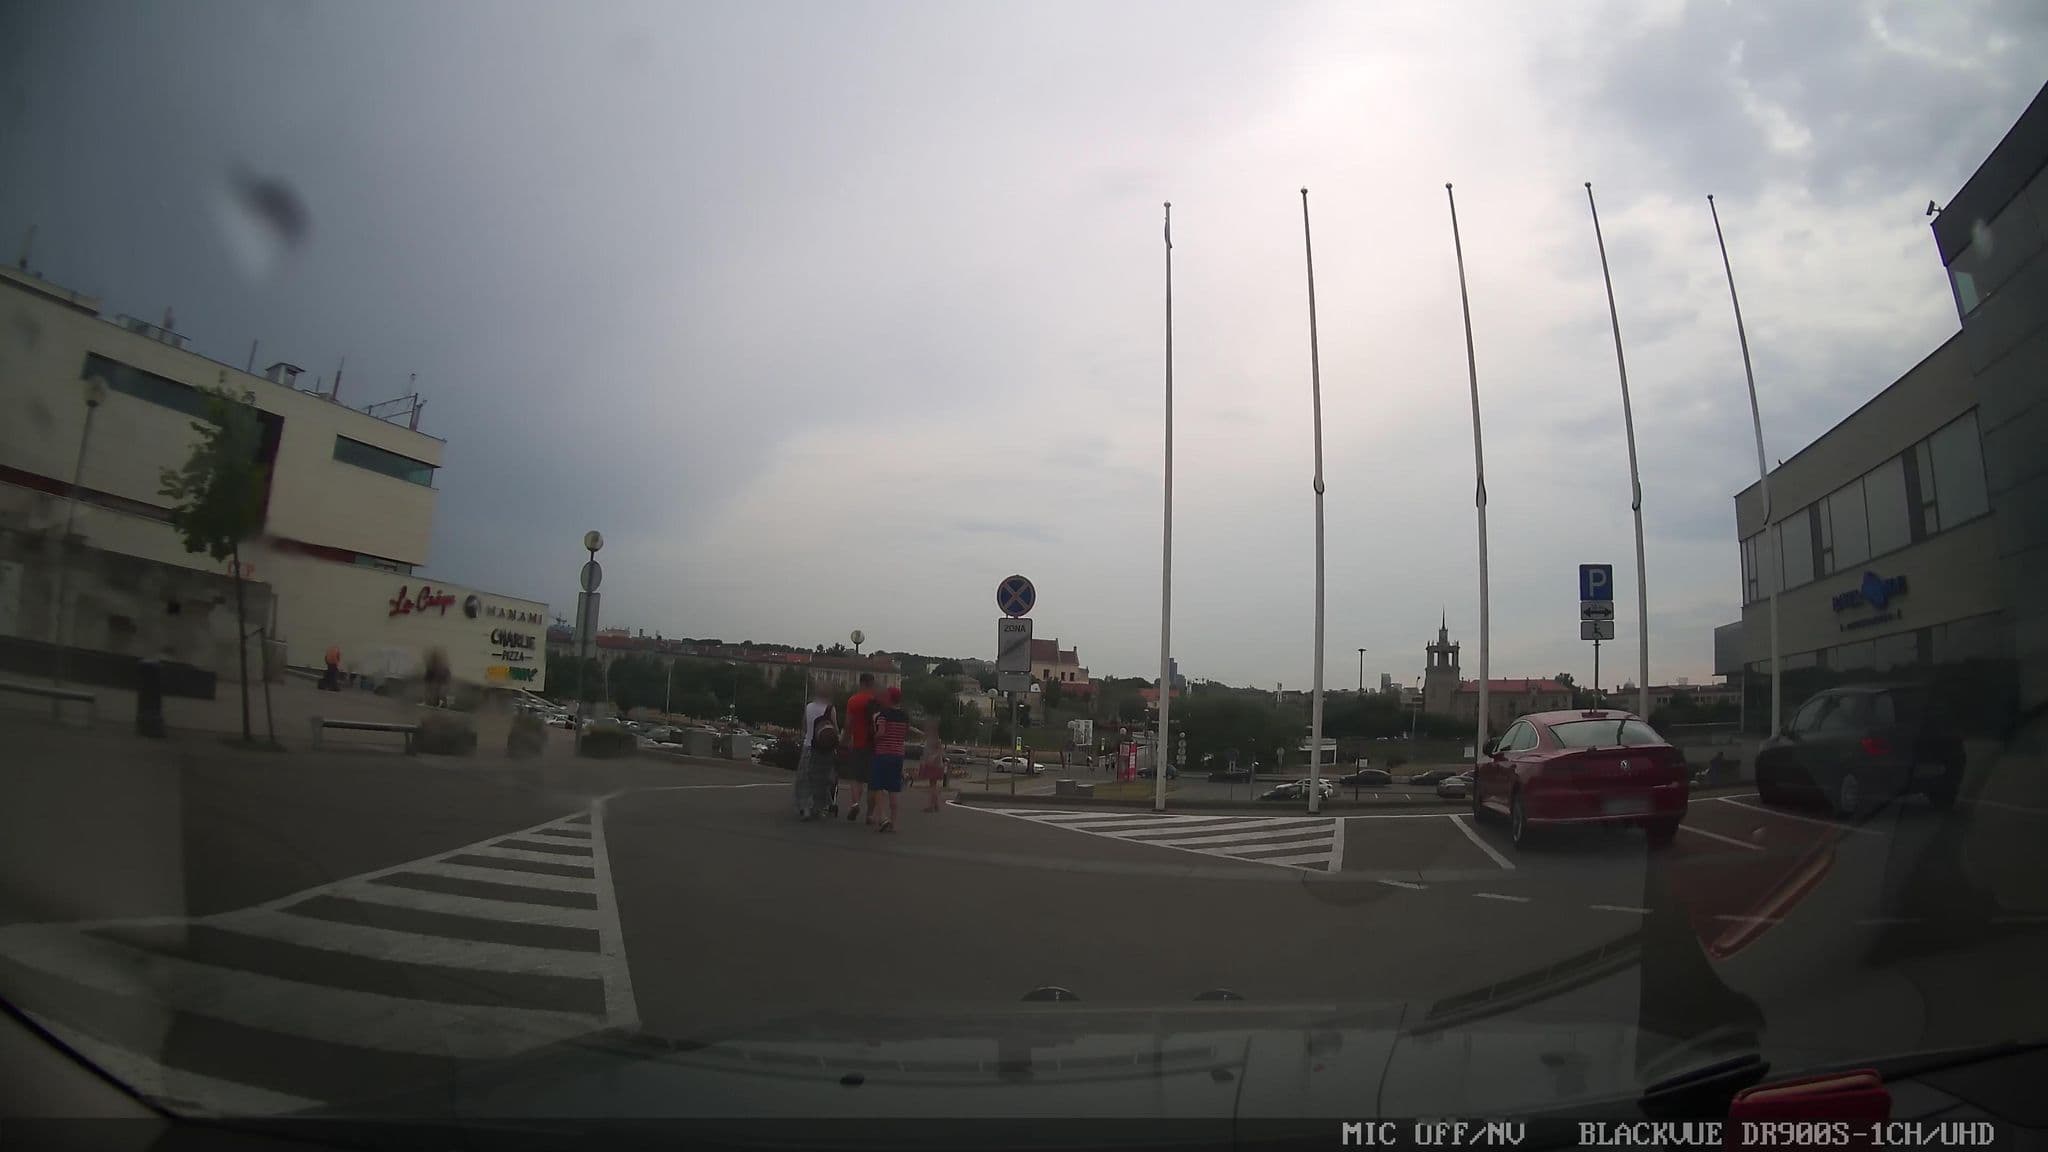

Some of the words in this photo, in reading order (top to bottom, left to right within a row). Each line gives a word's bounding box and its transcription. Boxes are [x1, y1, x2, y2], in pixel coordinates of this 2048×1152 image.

[1589, 568, 1606, 597] P
[1003, 624, 1026, 633] ZONA
[490, 628, 536, 649] CHARLIE
[501, 650, 525, 662] PIZZA
